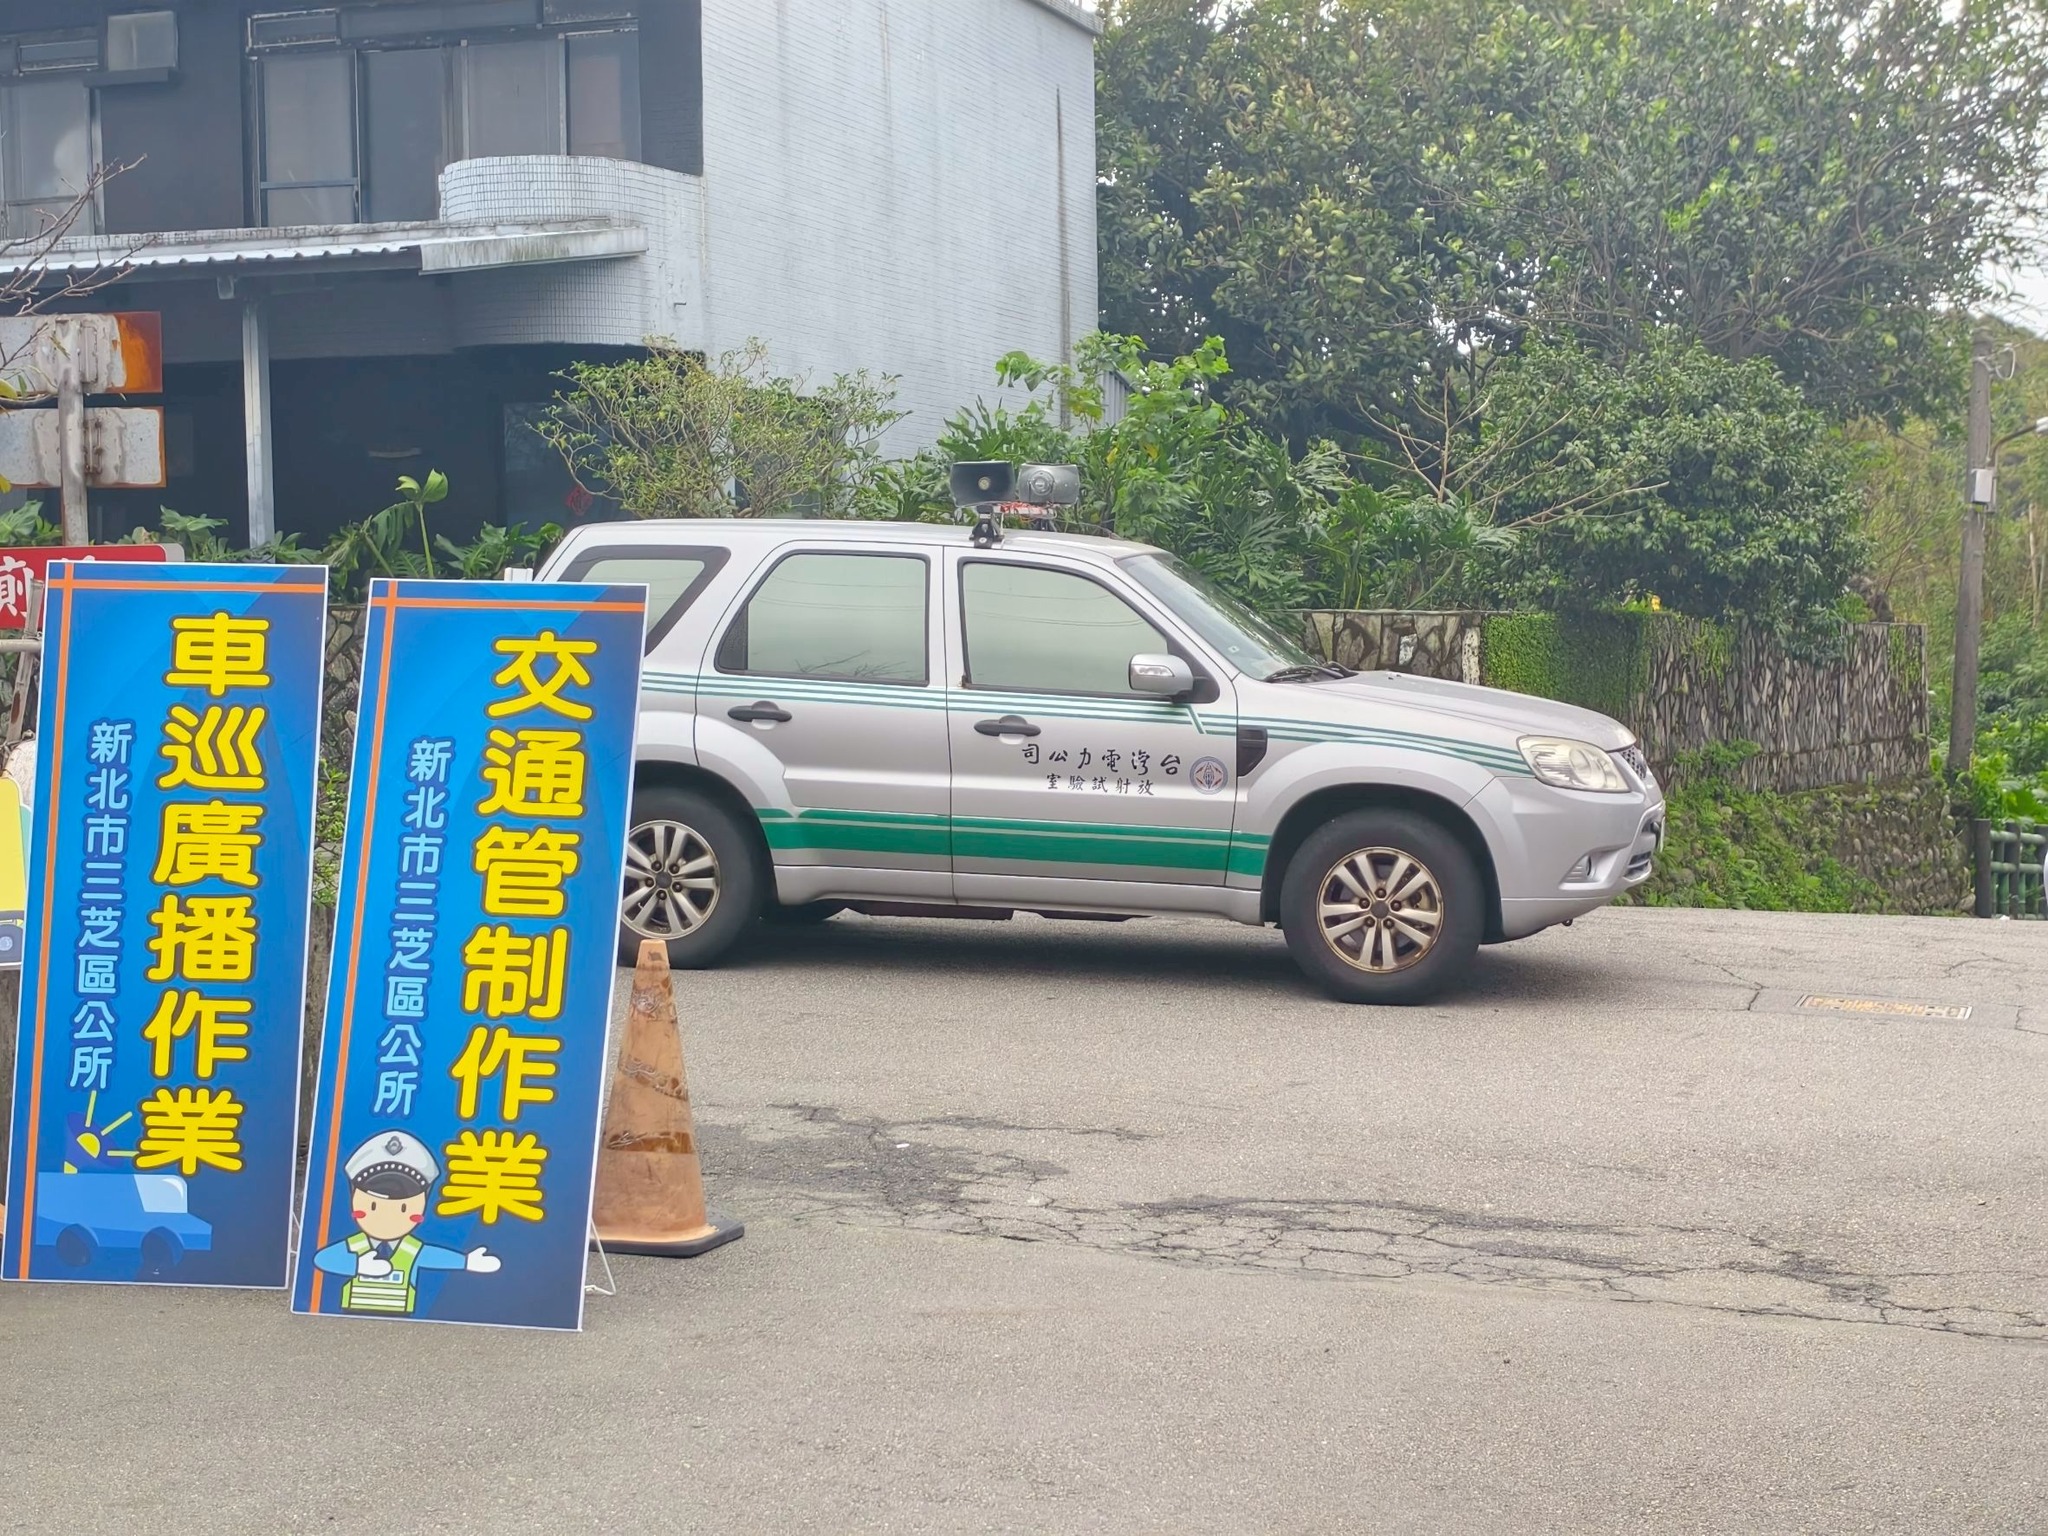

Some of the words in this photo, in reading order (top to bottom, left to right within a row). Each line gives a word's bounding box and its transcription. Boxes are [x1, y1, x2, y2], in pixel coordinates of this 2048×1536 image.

[70, 722, 133, 1090] 新北市三芝區公所
[136, 612, 269, 1175] 車巡廣播作業
[373, 739, 452, 1115] 新北市三芝區公所
[436, 631, 597, 1224] 交通管制作業
